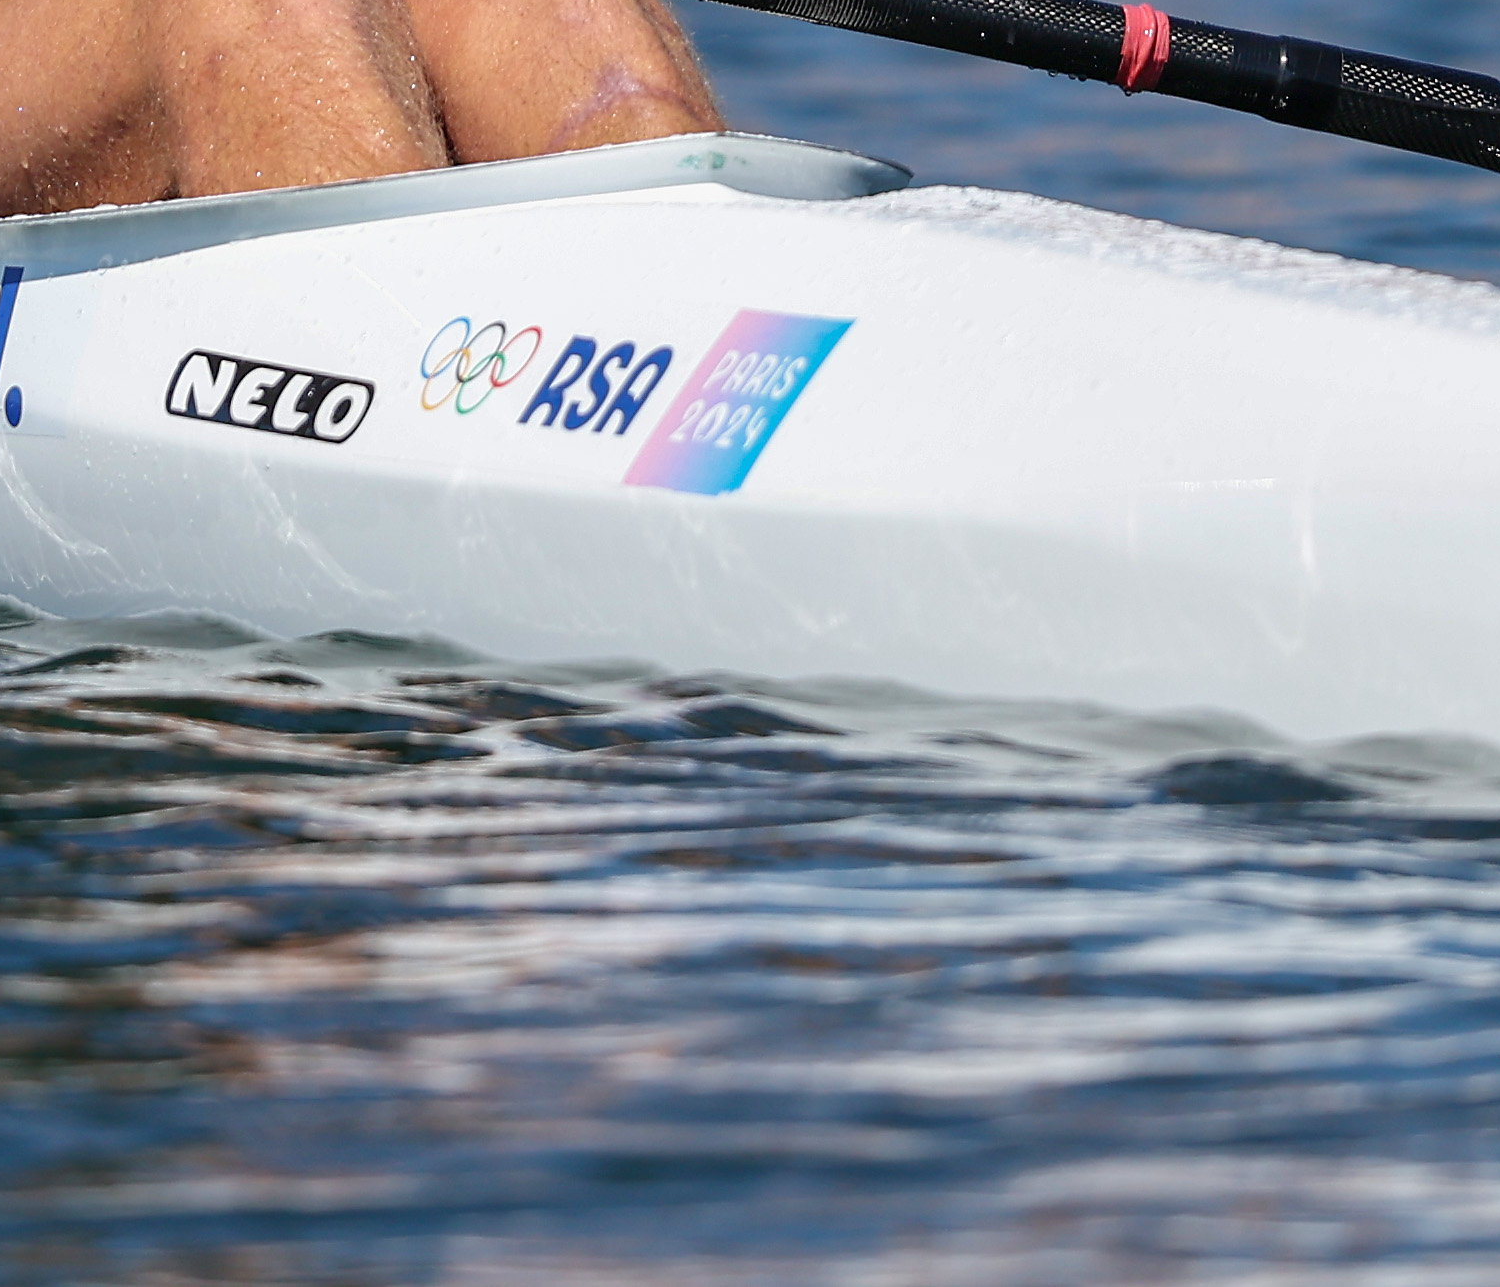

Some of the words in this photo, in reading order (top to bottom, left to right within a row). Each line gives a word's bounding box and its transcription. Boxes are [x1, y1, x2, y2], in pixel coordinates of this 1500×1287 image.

[173, 353, 369, 442] NELO
[518, 335, 673, 435] RSA
[668, 398, 769, 451] 2024
